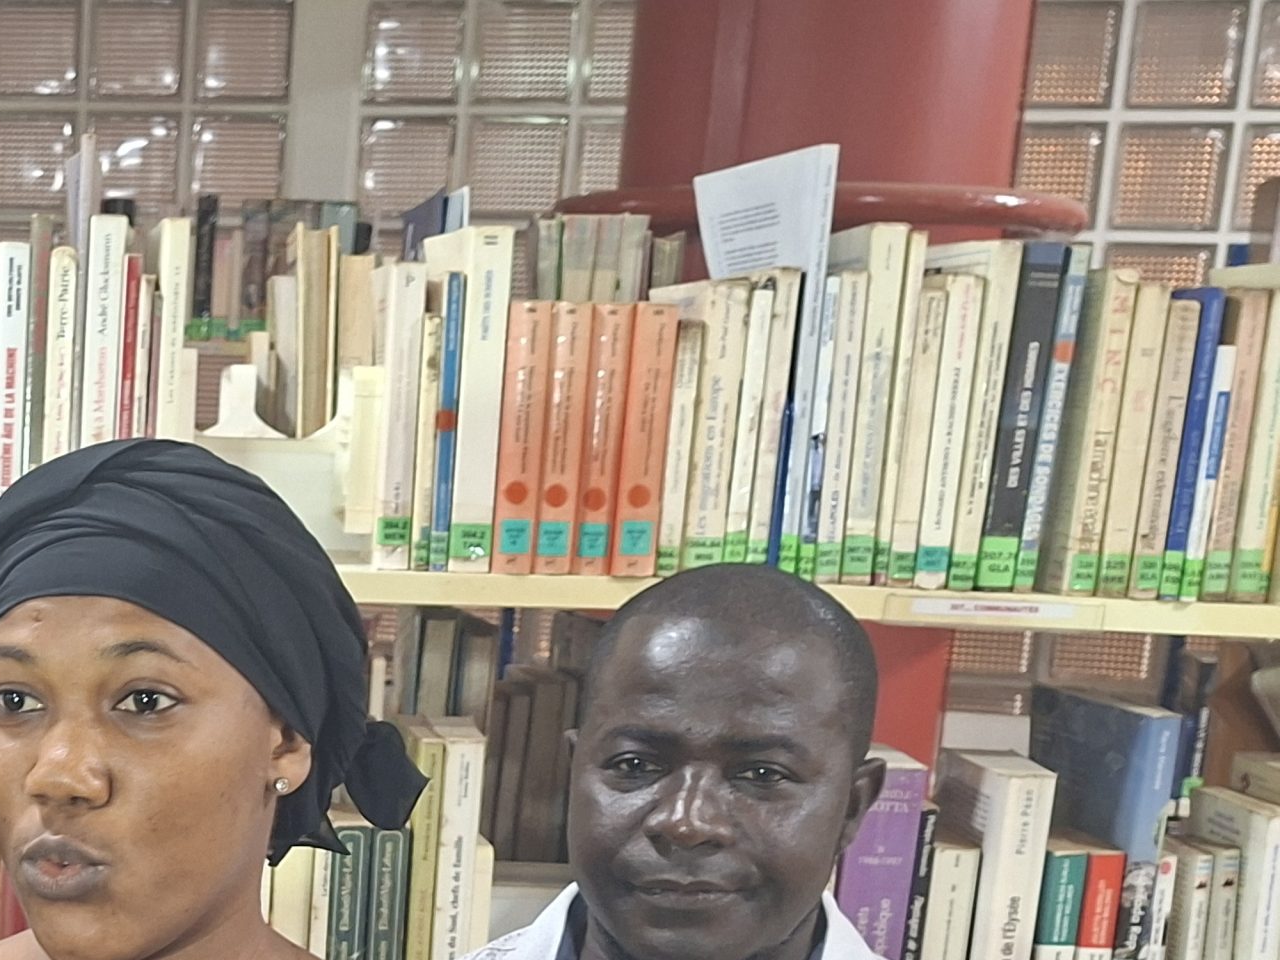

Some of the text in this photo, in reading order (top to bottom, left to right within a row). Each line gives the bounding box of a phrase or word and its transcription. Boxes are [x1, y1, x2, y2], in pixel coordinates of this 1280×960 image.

[55, 265, 71, 341] Terre-Patrie
[96, 303, 109, 337] André
[705, 375, 723, 421] Europe
[1019, 390, 1032, 412] DES
[0, 346, 18, 487] DEUXIÈME ÂGE DE LA MACHINE
[1017, 413, 1028, 427] ET
[1009, 428, 1027, 464] VILLES
[1038, 443, 1055, 463] DE
[1006, 467, 1021, 488] DES
[1085, 449, 1110, 507] machine
[1022, 465, 1049, 540] SONDAGES
[452, 835, 464, 869] famille
[1015, 819, 1029, 856] Pierre
[452, 871, 462, 883] de
[450, 884, 462, 910] chefs
[1001, 895, 1022, 940] l'Élysée
[1001, 942, 1014, 957] de
